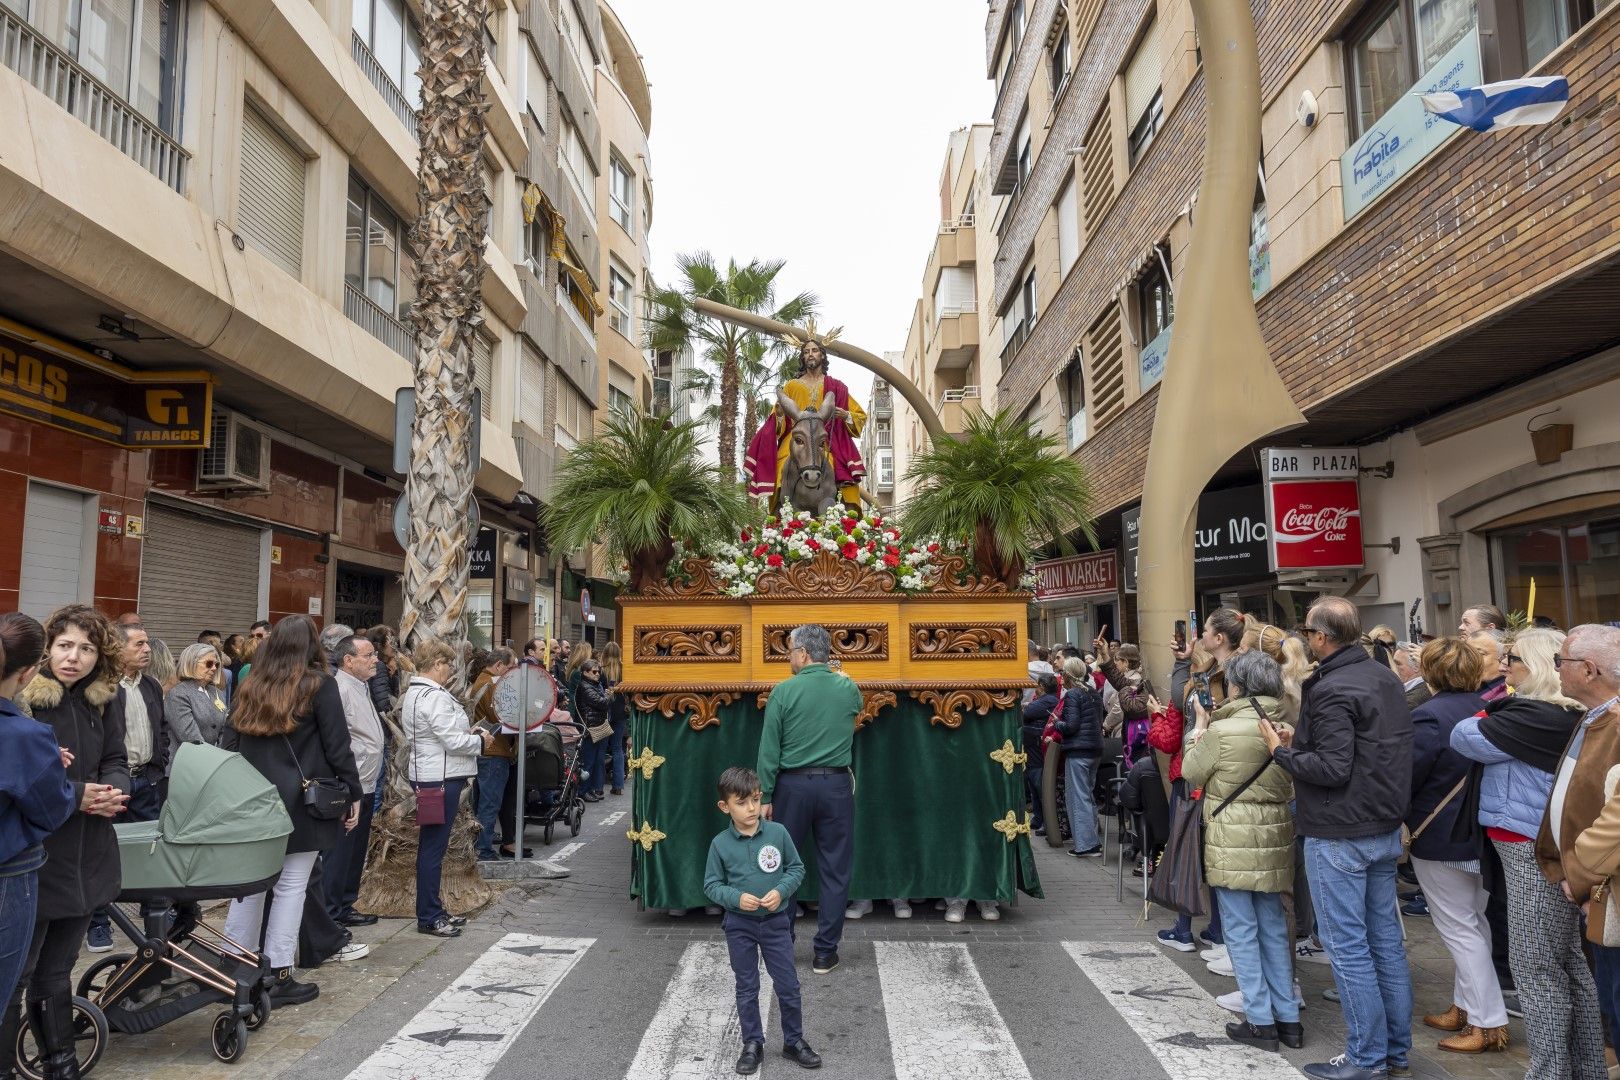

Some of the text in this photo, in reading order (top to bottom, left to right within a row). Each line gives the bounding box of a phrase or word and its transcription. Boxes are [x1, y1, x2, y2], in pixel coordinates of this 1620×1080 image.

[1438, 60, 1465, 88] agents
[1353, 136, 1400, 184] habita
[134, 430, 200, 441] TABACOS
[1272, 455, 1358, 472] BAR PLAZA
[1282, 507, 1348, 531] Coca-Cola
[1325, 531, 1346, 541] Coke
[1039, 566, 1063, 590] MINI
[1066, 557, 1113, 586] MARKET
